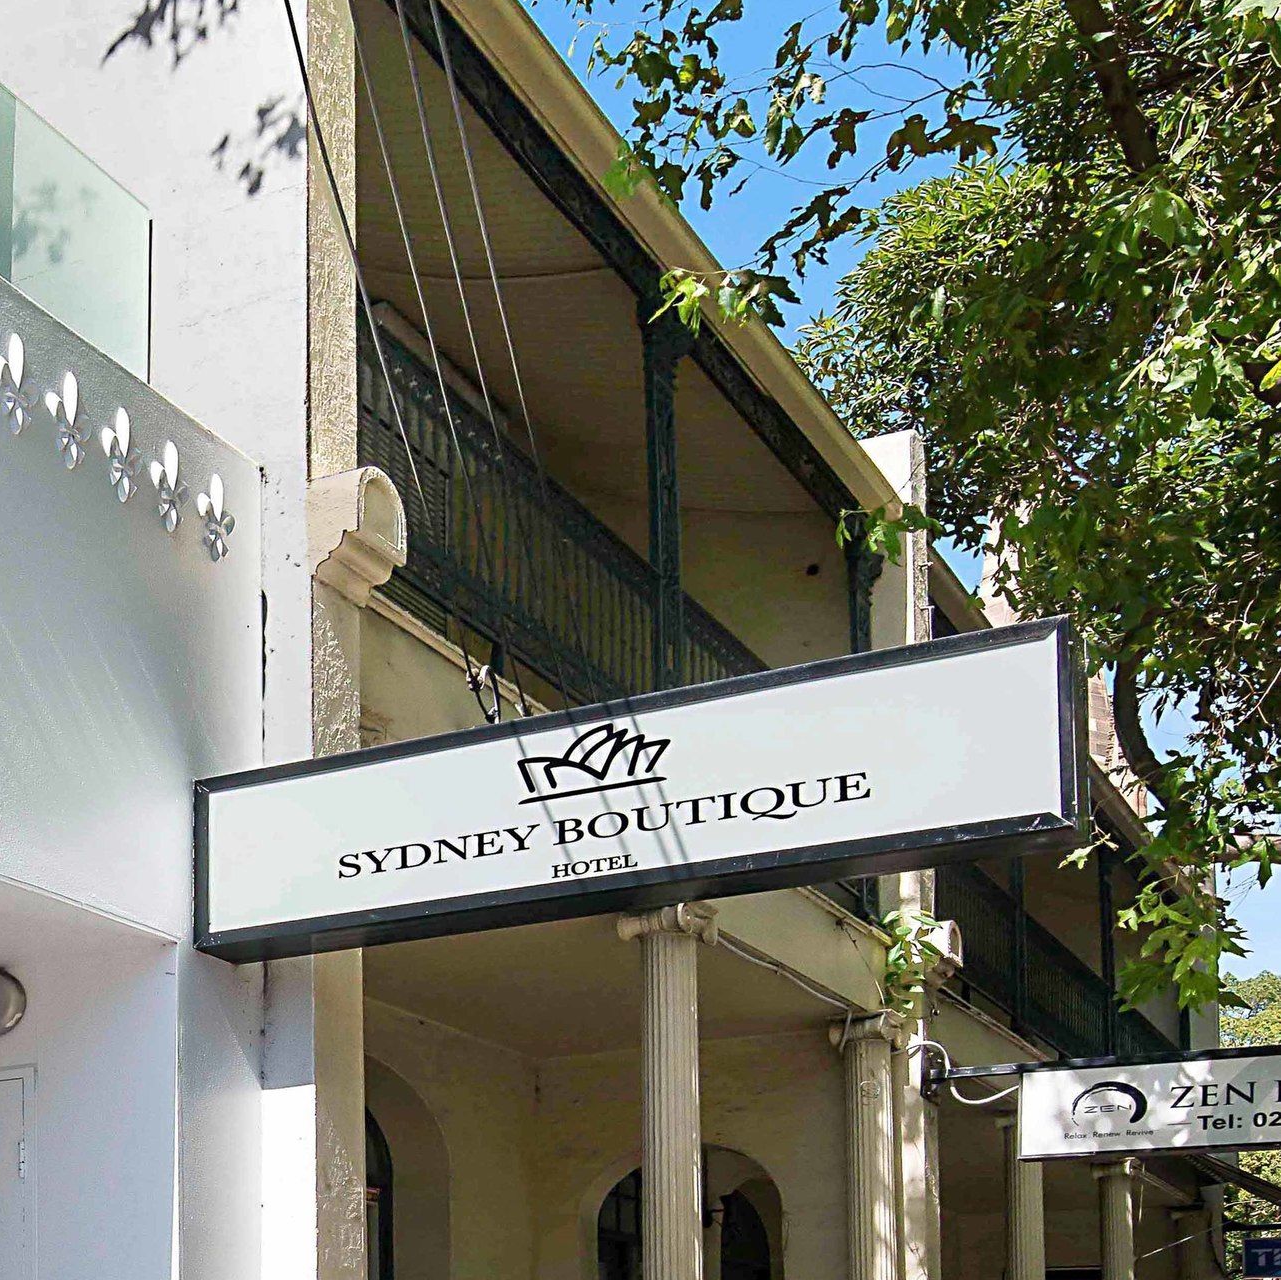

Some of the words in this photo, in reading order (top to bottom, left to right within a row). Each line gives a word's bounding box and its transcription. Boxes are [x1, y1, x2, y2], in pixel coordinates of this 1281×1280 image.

[338, 824, 539, 879] SYDNEY
[553, 773, 871, 846] BOUTIQUE
[551, 854, 638, 879] HOTEL
[1171, 1081, 1257, 1109] ZEN
[1084, 1104, 1132, 1114] ZEN
[1197, 1114, 1242, 1130] Tel:
[1064, 1131, 1087, 1140] Relax
[1093, 1131, 1120, 1139] Renew
[1126, 1129, 1154, 1137] Revive
